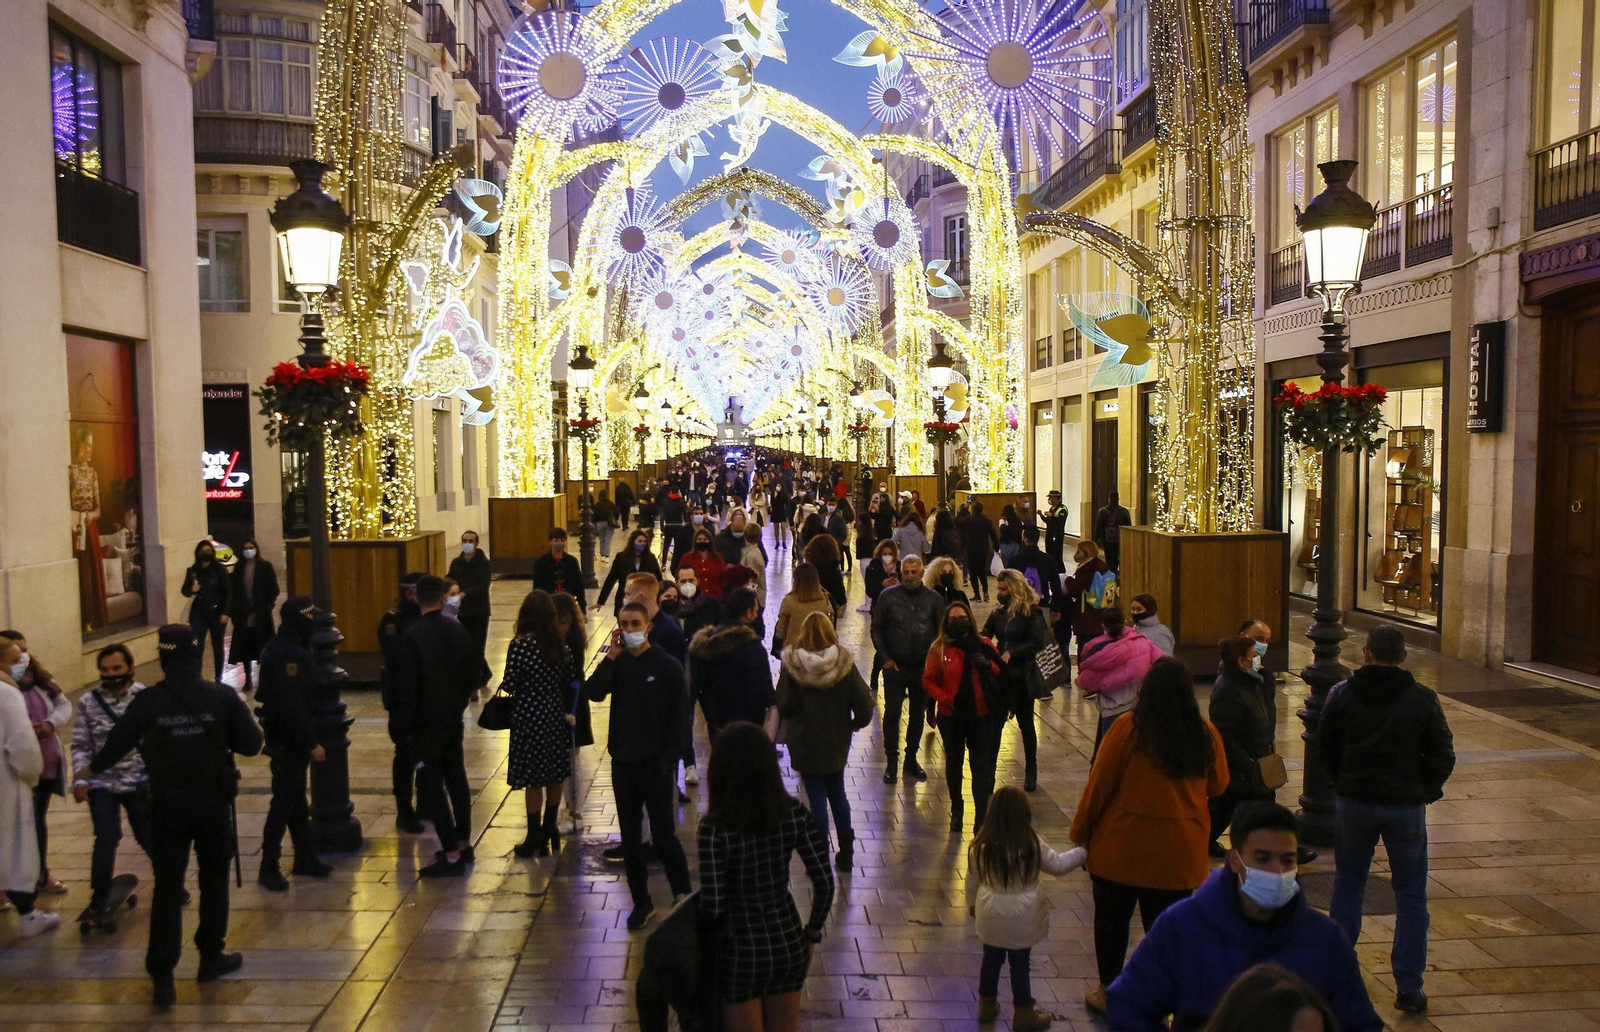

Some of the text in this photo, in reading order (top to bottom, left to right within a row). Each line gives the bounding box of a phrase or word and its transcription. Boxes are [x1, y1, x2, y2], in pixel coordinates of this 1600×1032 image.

[1468, 329, 1480, 416] HOSTAL
[203, 389, 243, 399] ntander
[203, 489, 243, 499] antander
